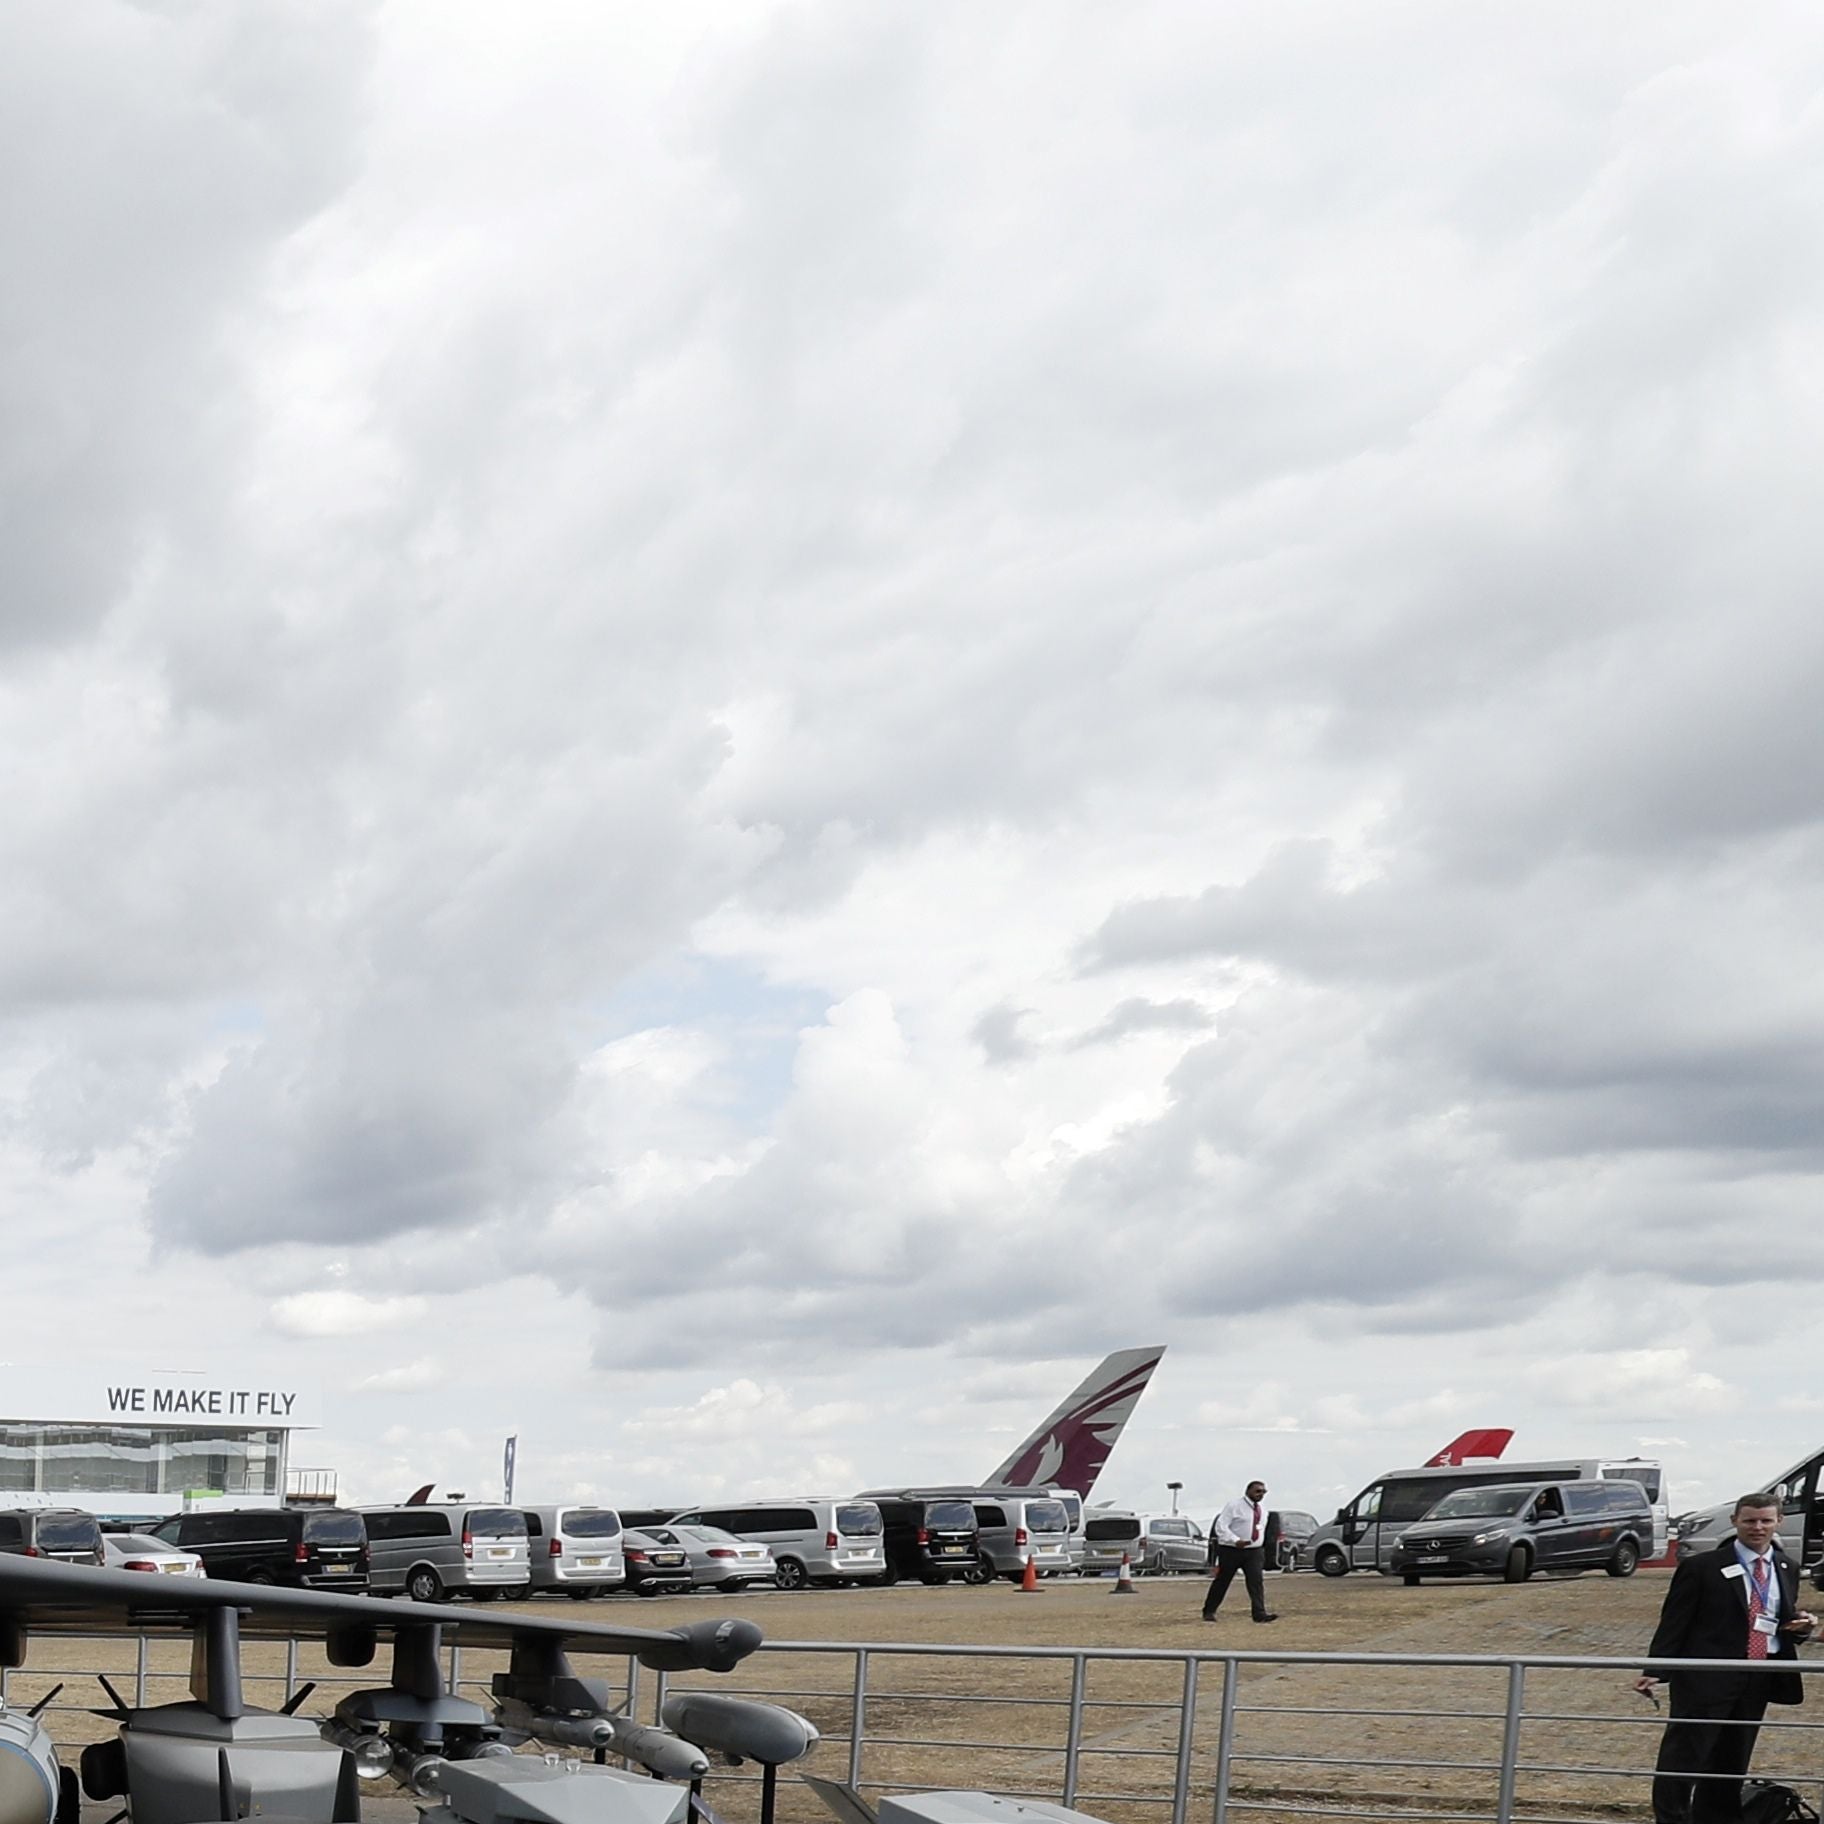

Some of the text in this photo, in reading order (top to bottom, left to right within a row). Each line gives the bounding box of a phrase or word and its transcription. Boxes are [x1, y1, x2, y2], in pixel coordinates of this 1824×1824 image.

[107, 1387, 297, 1415] WE MAKE IT FLY
